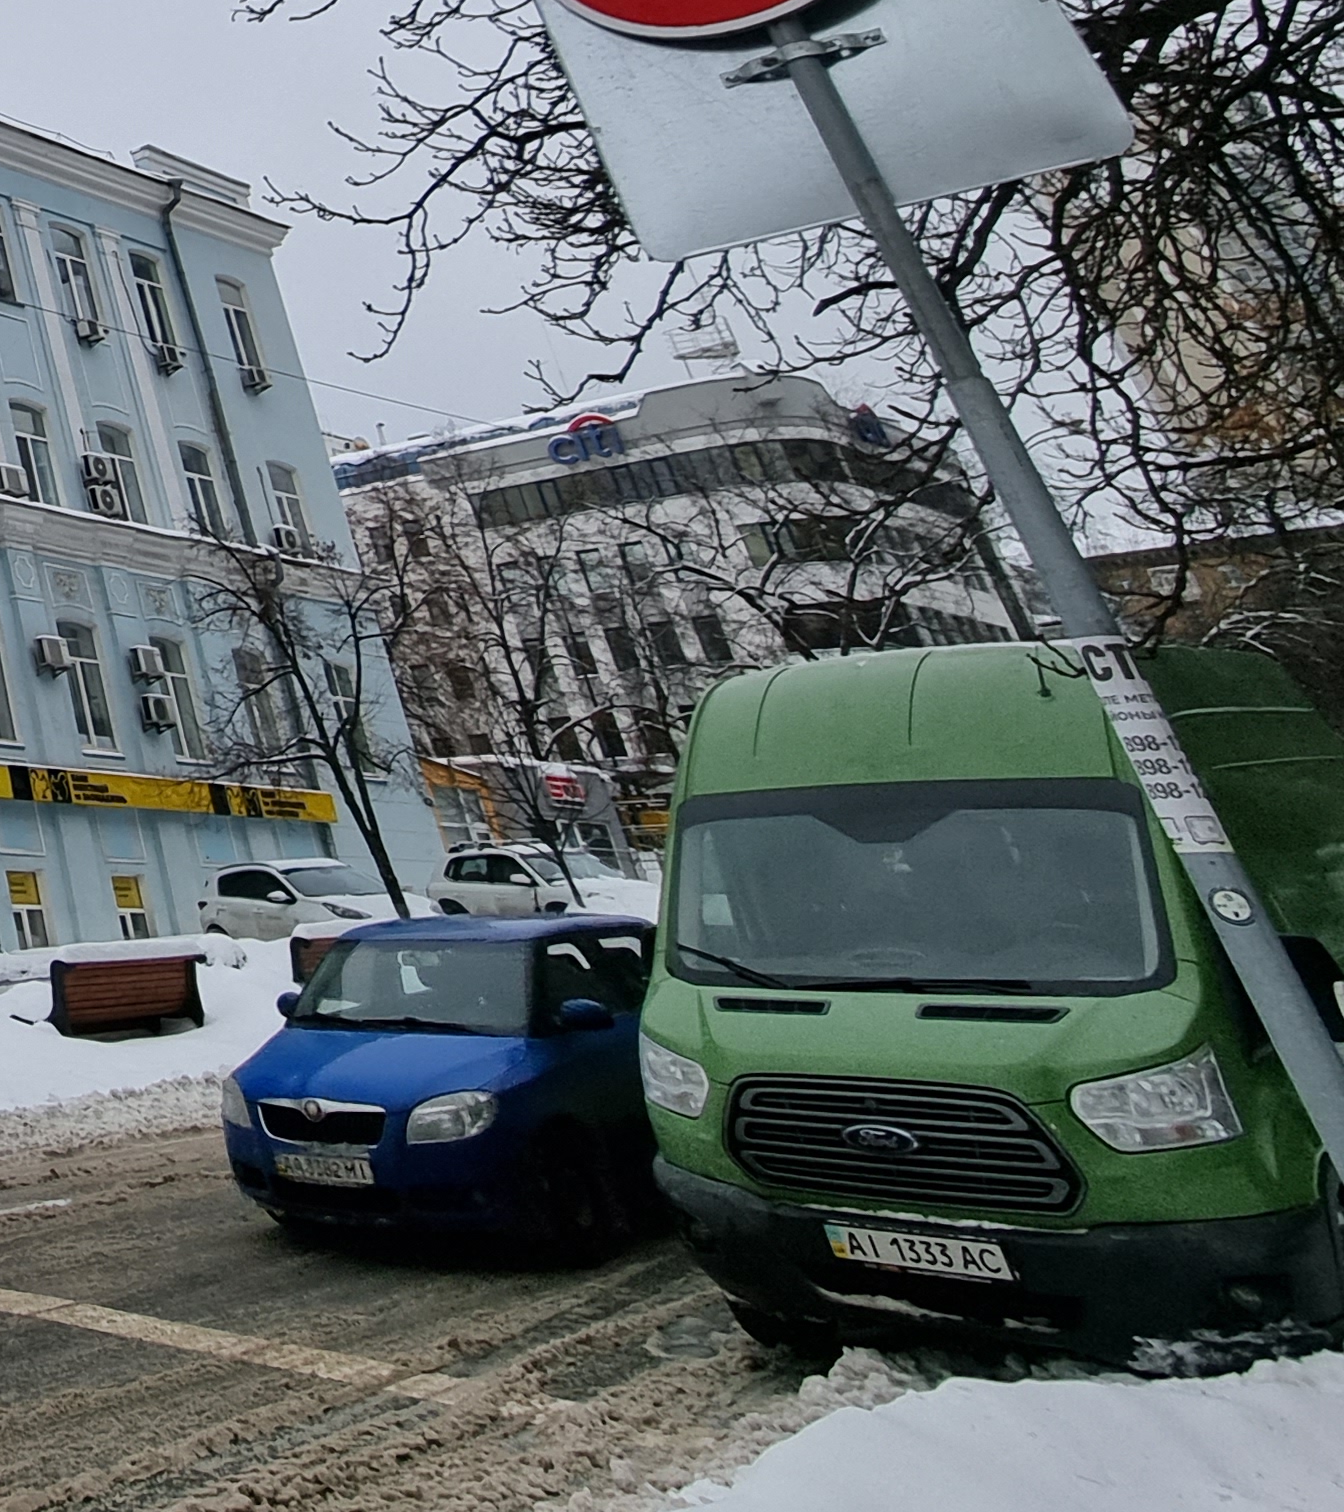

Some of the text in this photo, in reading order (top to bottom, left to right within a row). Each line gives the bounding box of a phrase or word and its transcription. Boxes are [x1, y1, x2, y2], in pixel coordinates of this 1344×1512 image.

[847, 1231, 1002, 1273] AI 1333 AC
